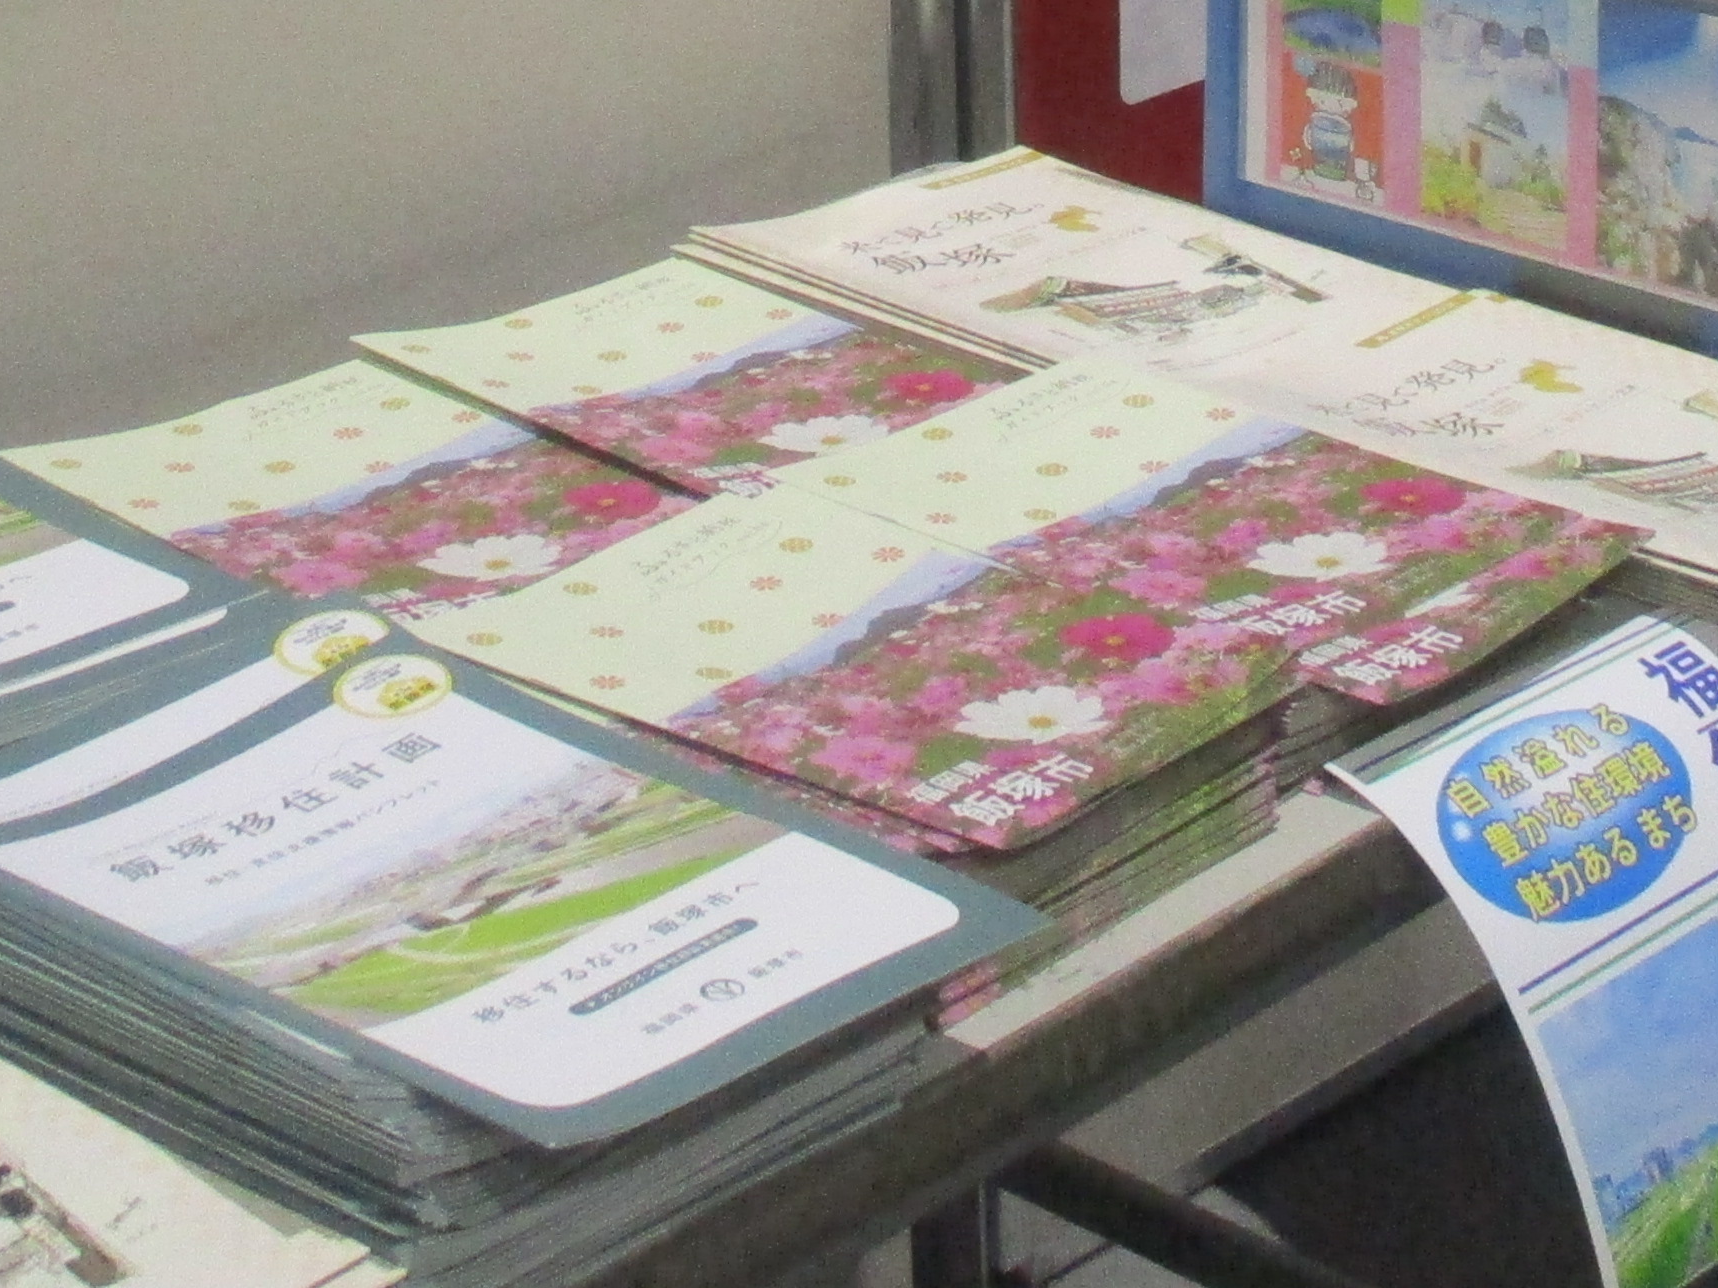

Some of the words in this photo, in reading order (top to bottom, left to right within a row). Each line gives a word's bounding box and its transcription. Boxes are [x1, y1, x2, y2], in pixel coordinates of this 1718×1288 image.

[1331, 625, 1464, 686] 飯塚市
[109, 732, 442, 884] 飯塚移住計画
[947, 752, 1096, 826] 飯塚市
[1445, 701, 1631, 819] 自然溢れる
[1481, 740, 1671, 868] 豊かな住環境
